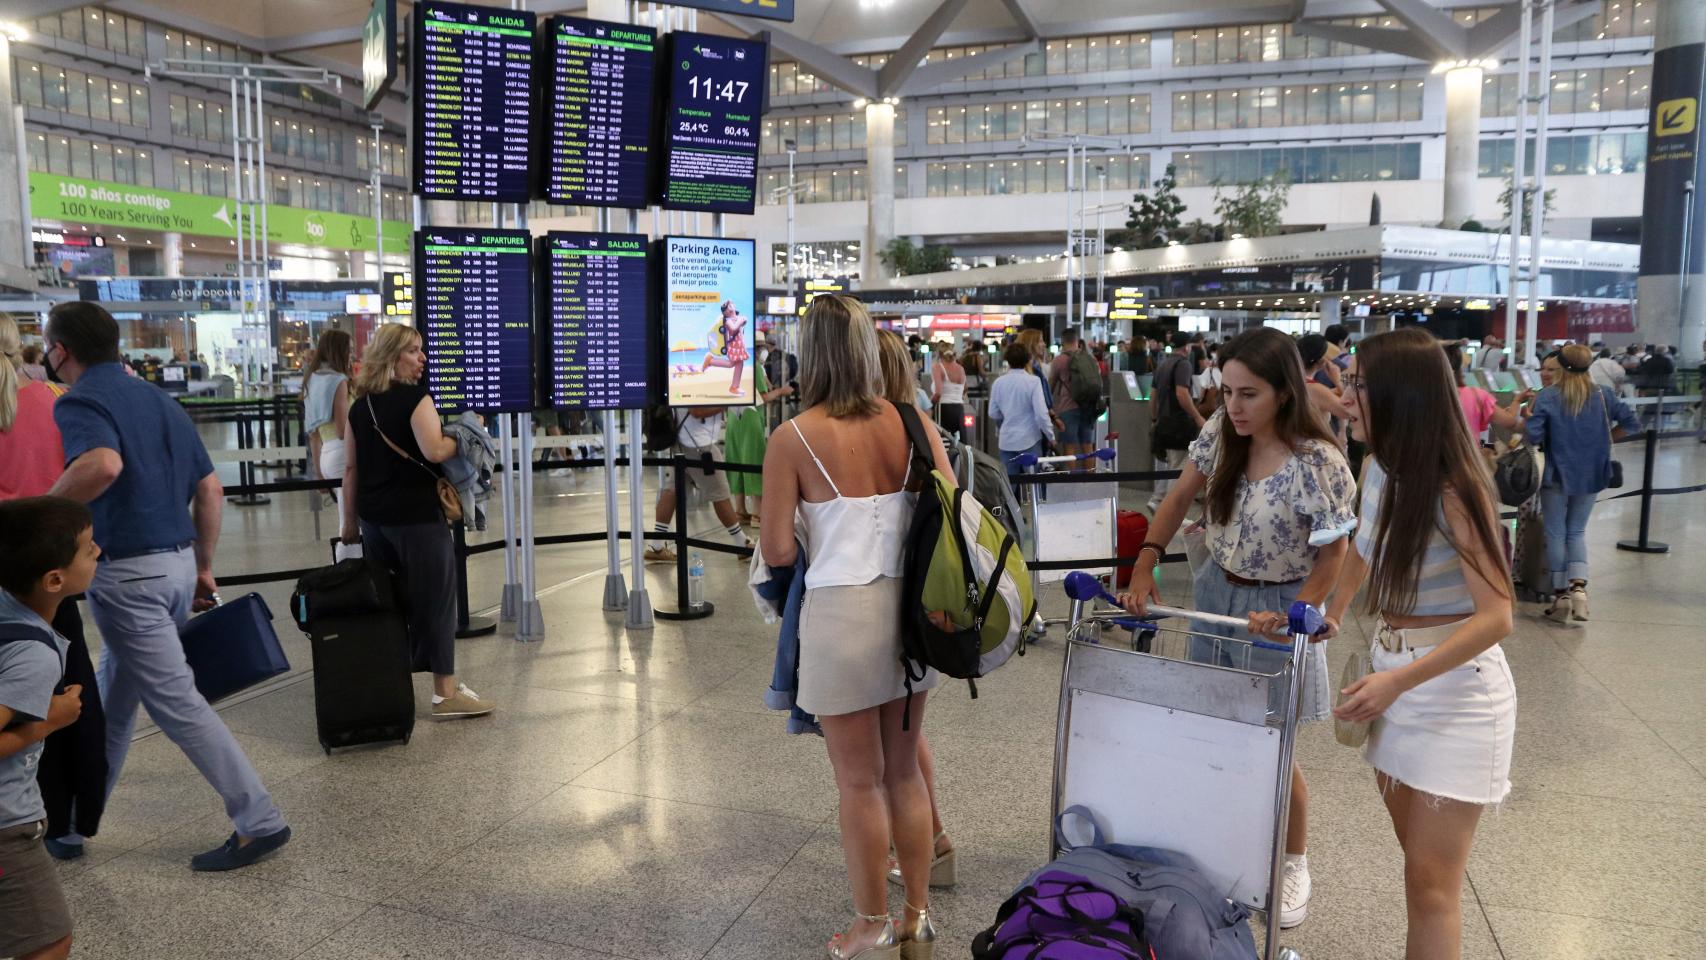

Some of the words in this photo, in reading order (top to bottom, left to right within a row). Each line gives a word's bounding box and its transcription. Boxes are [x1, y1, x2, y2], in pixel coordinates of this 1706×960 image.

[489, 15, 525, 27] SALIDAS
[611, 30, 651, 42] DEPARTURES
[689, 76, 749, 103] 11:47
[678, 108, 712, 118] Temperatura
[726, 112, 751, 121] Humedad
[60, 182, 86, 198] 100
[90, 187, 121, 202] años
[124, 192, 171, 211] contigo
[62, 201, 86, 218] 100
[90, 205, 124, 222] Years
[128, 209, 170, 228] Serving
[173, 214, 193, 228] You
[306, 222, 324, 235] 100
[482, 236, 524, 245] DEPARTURES
[608, 240, 640, 248] SALIDAS
[672, 244, 710, 256] Parking
[712, 245, 740, 256] Aena.
[708, 265, 731, 273] parking
